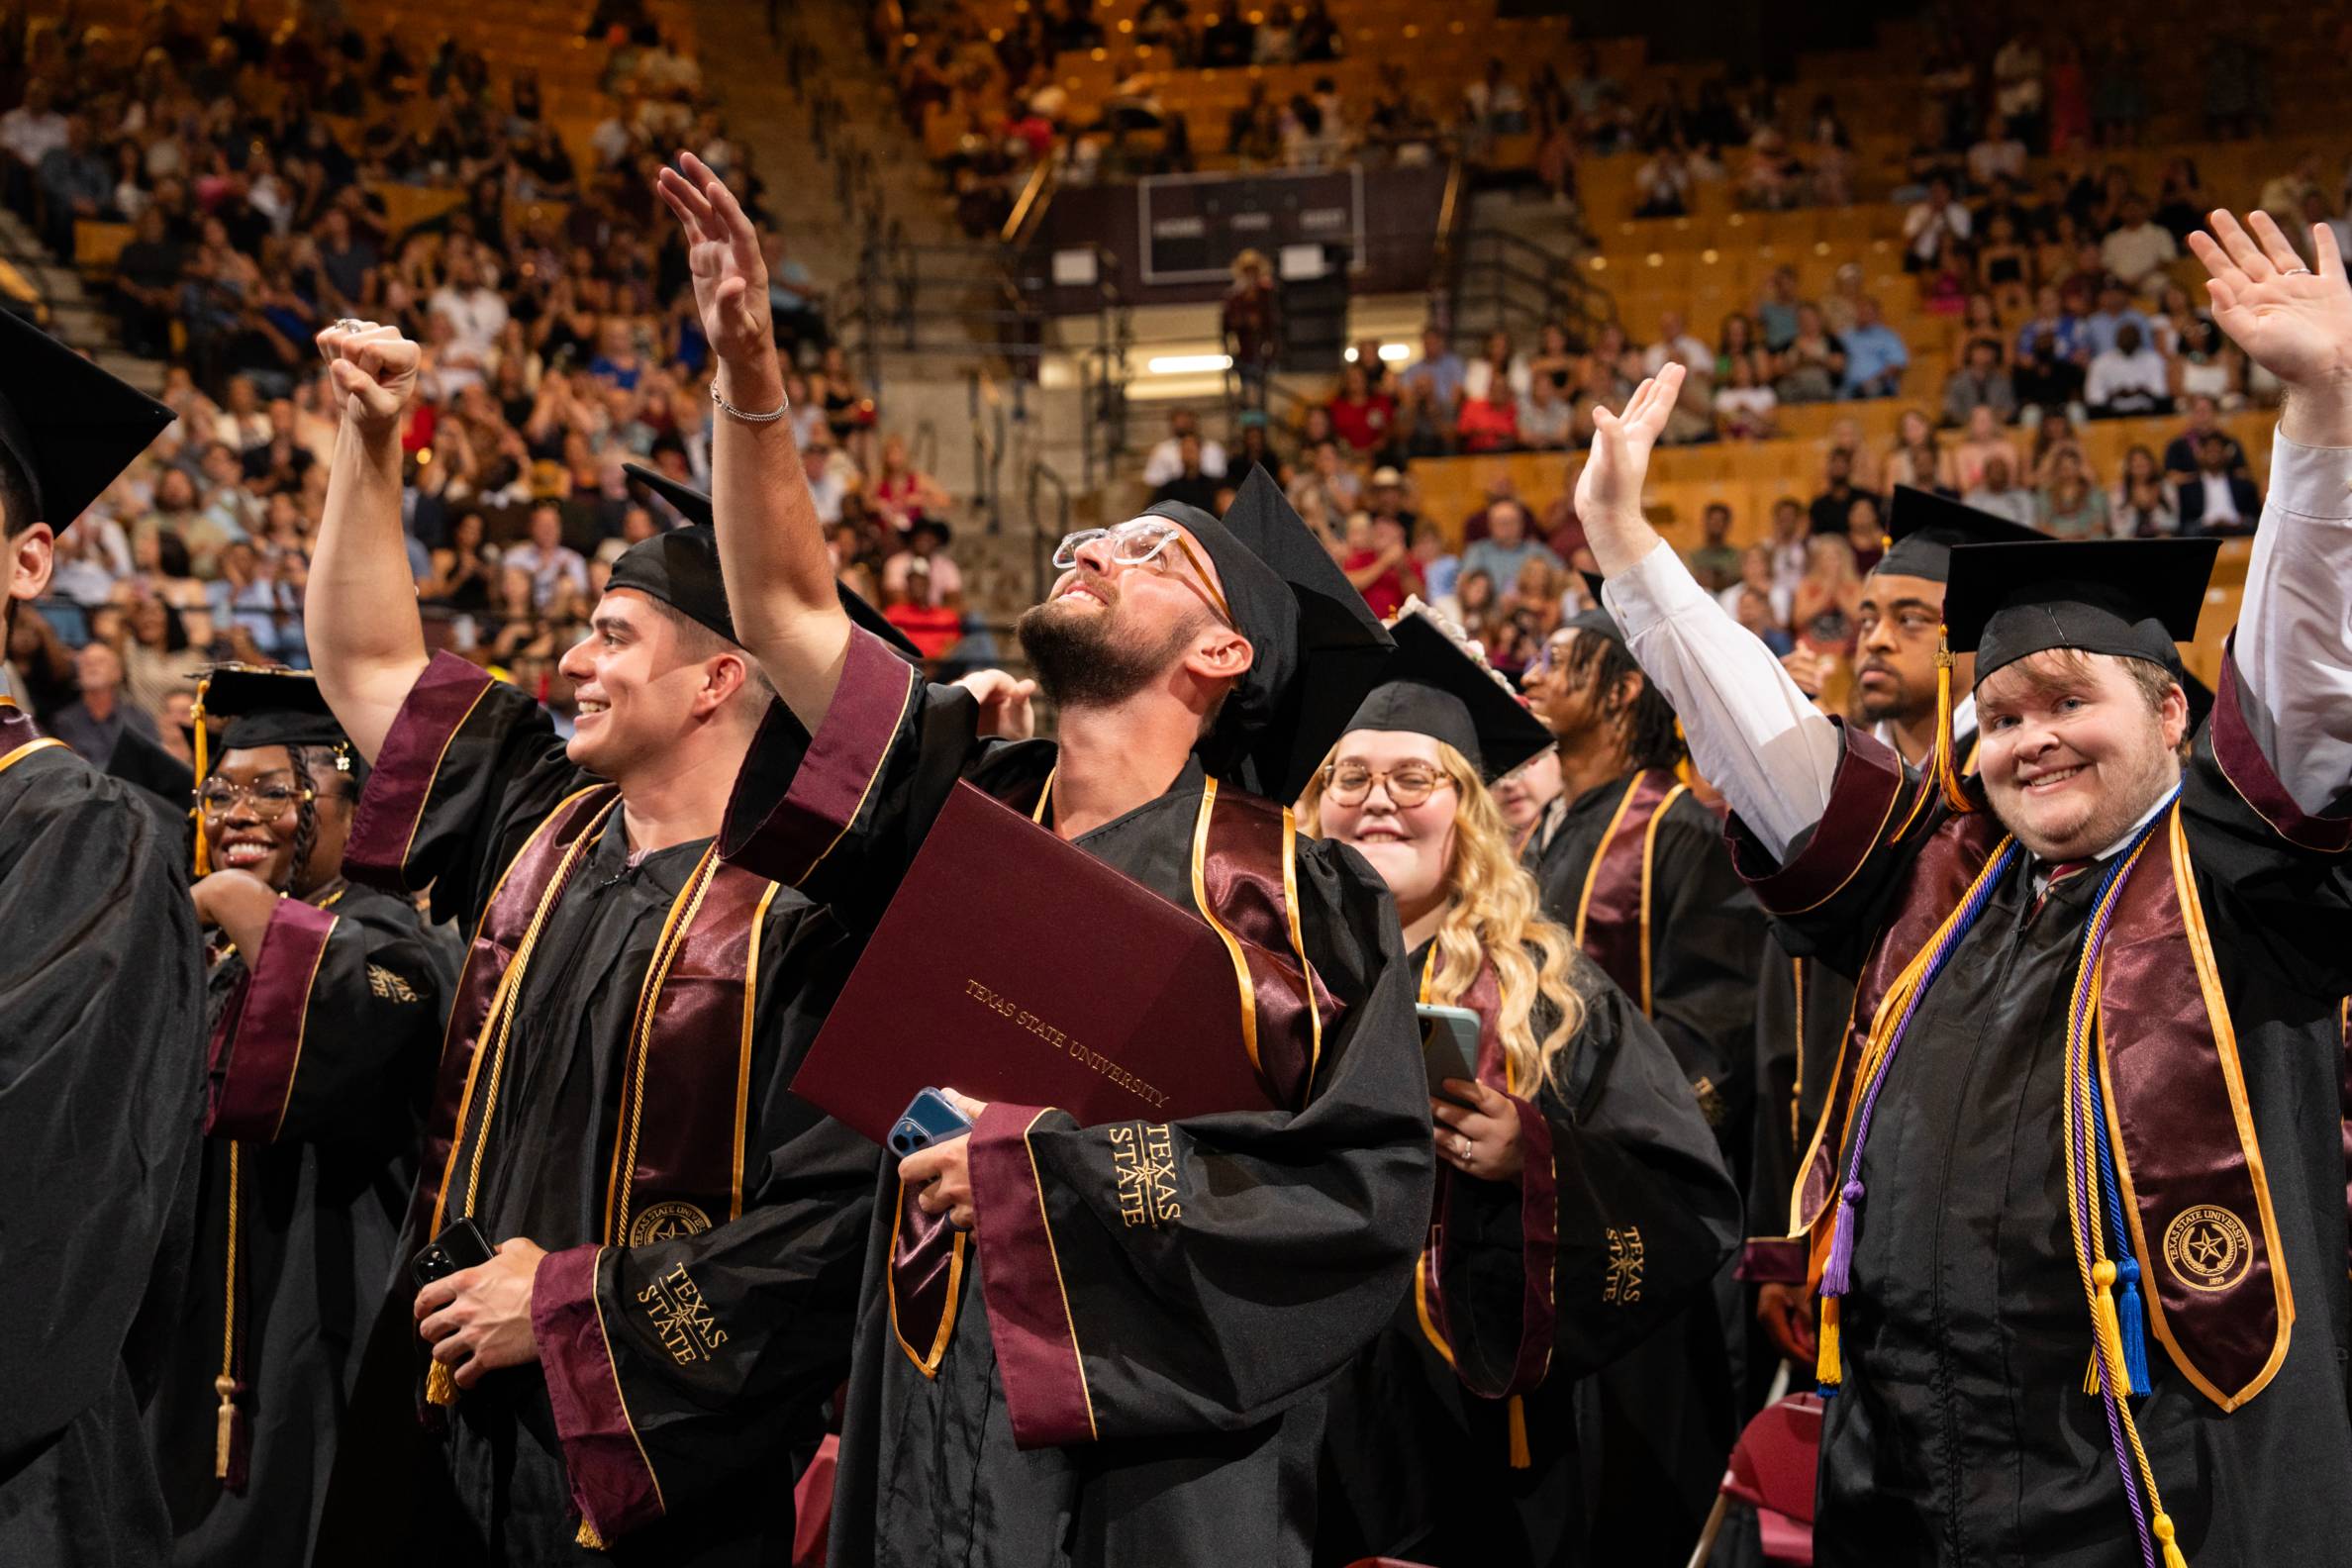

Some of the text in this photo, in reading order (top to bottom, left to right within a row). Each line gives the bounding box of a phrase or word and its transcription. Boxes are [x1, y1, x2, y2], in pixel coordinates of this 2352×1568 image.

[965, 979, 1170, 1109] TEXAS STATE UNIVERSITY
[1109, 1127, 1145, 1227] STATE
[1146, 1124, 1181, 1220] TEXAS
[648, 1206, 675, 1220] STATE
[677, 1207, 705, 1231] UNIVER
[2169, 1211, 2248, 1263] TEXAS STATE UNIVERSITY
[1603, 1227, 1623, 1302] STATE
[1623, 1226, 1644, 1302] TEXAS
[637, 1285, 697, 1366] STATE
[666, 1262, 729, 1348] TEXAS
